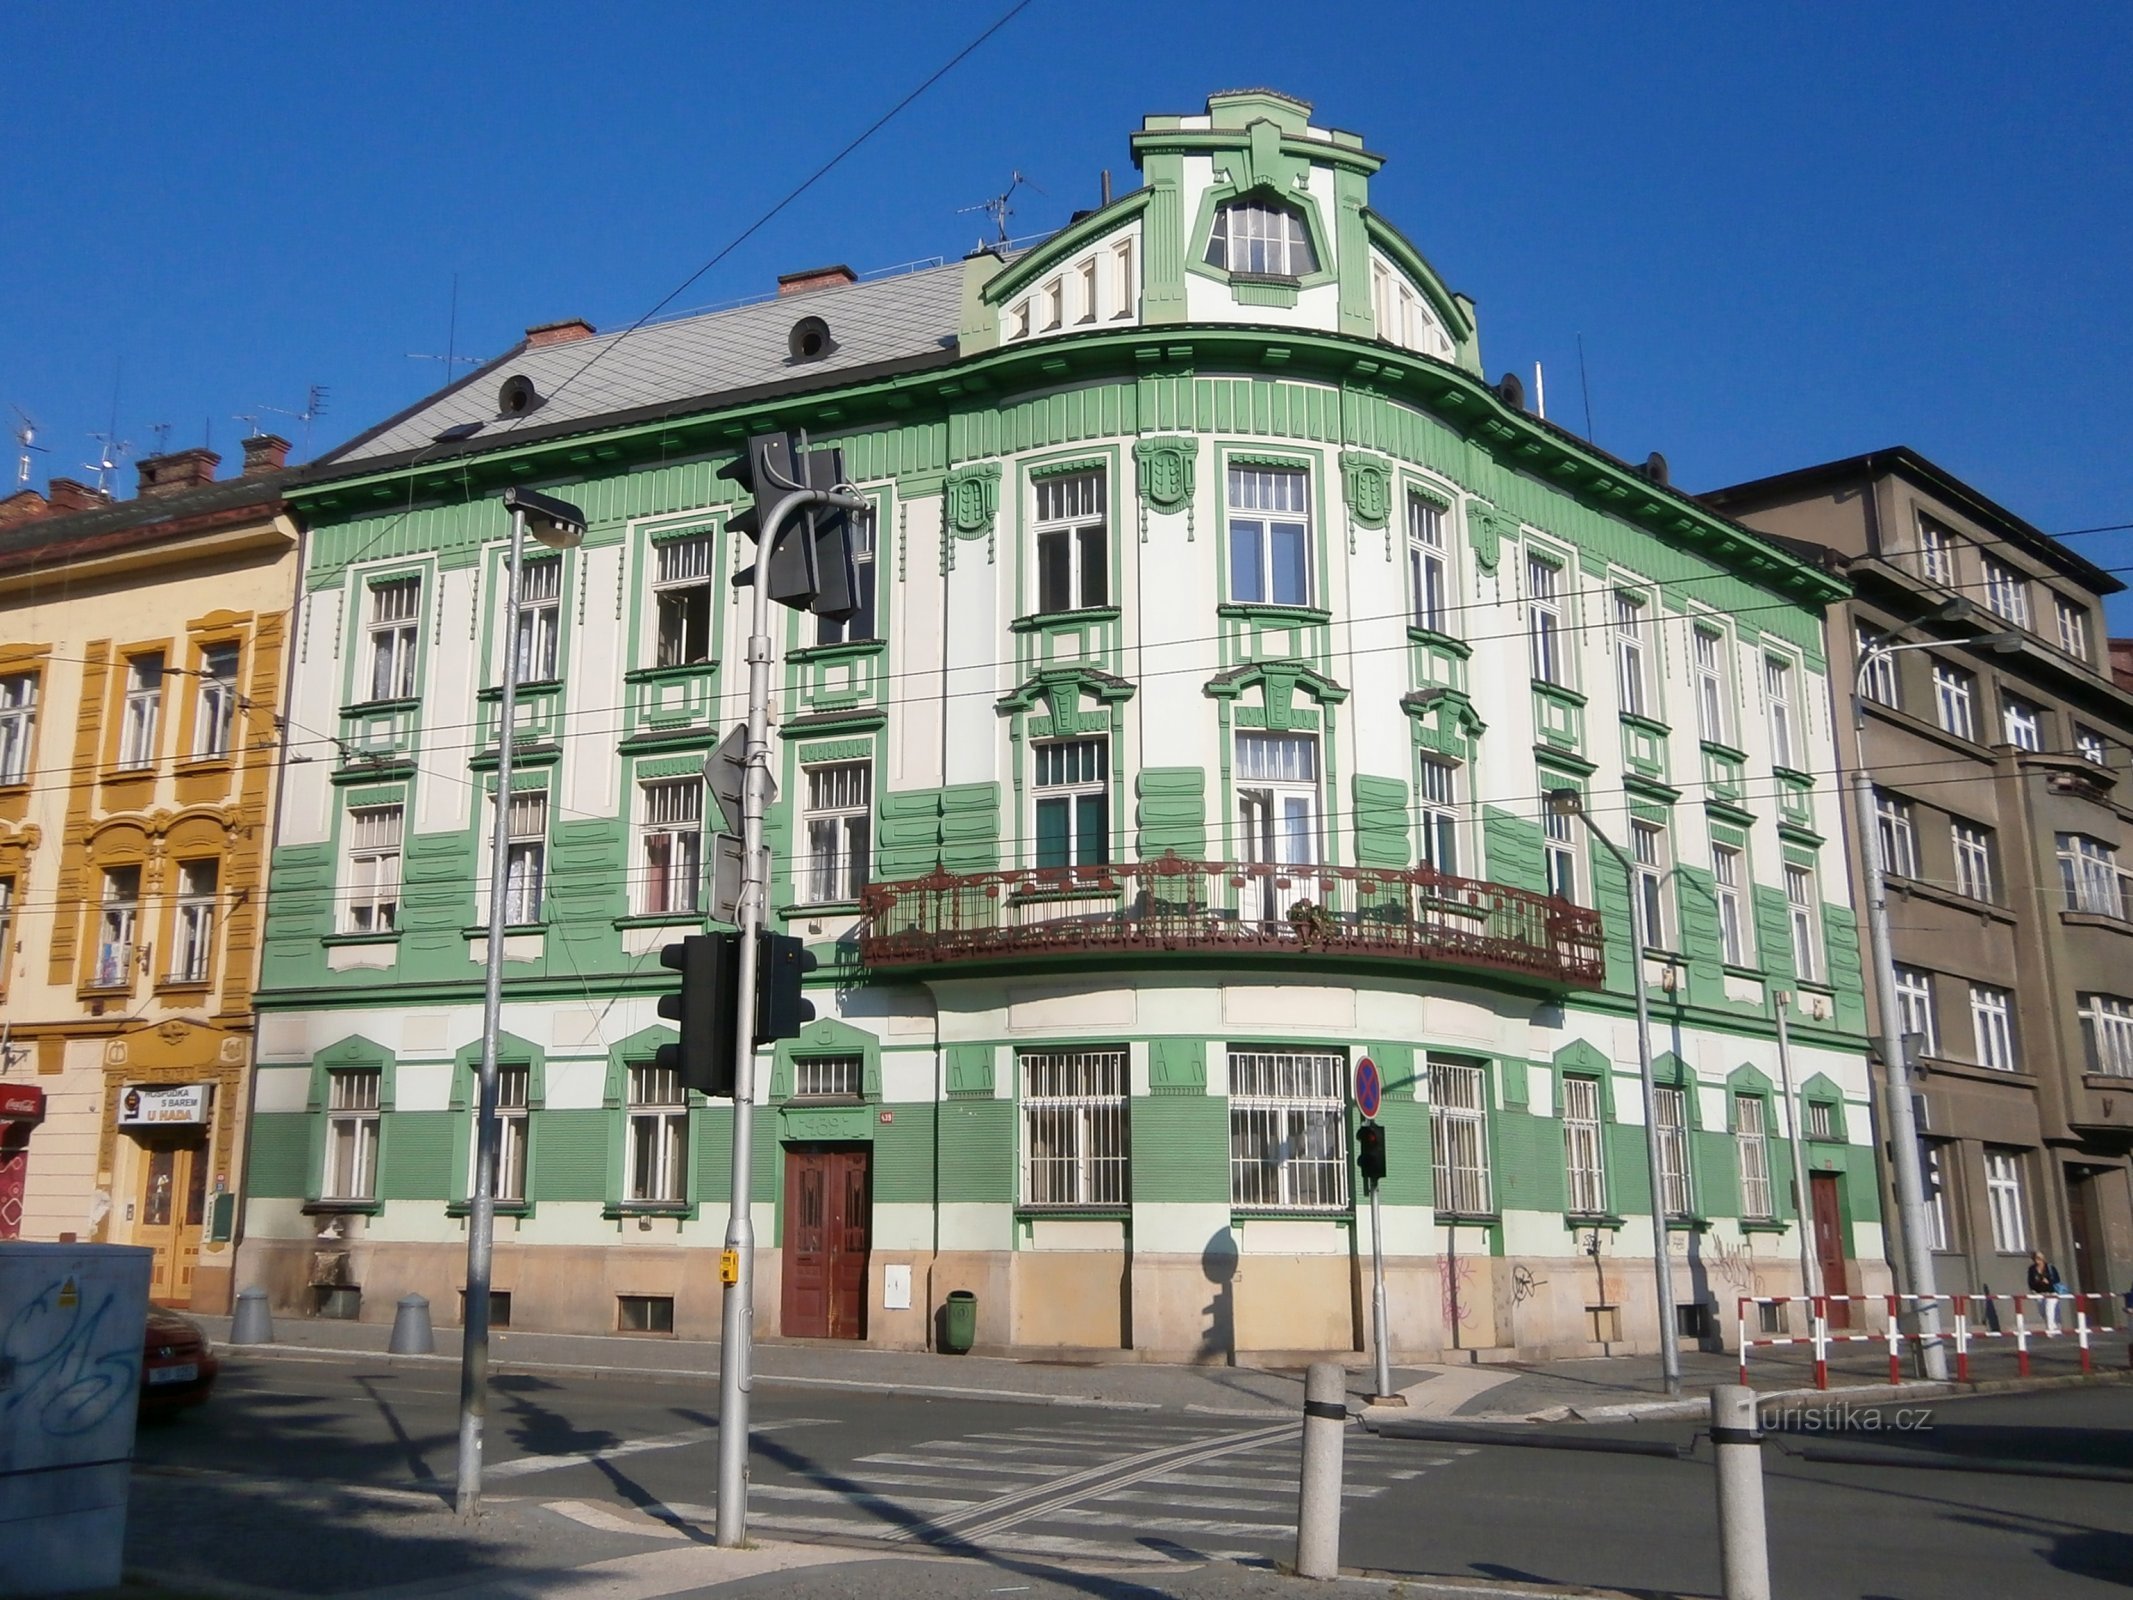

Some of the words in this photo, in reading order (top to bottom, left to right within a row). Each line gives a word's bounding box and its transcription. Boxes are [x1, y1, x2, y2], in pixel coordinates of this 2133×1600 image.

[161, 1099, 167, 1107] S
[168, 1099, 198, 1107] BAREM
[147, 1110, 156, 1121] U
[160, 1109, 192, 1121] HADA
